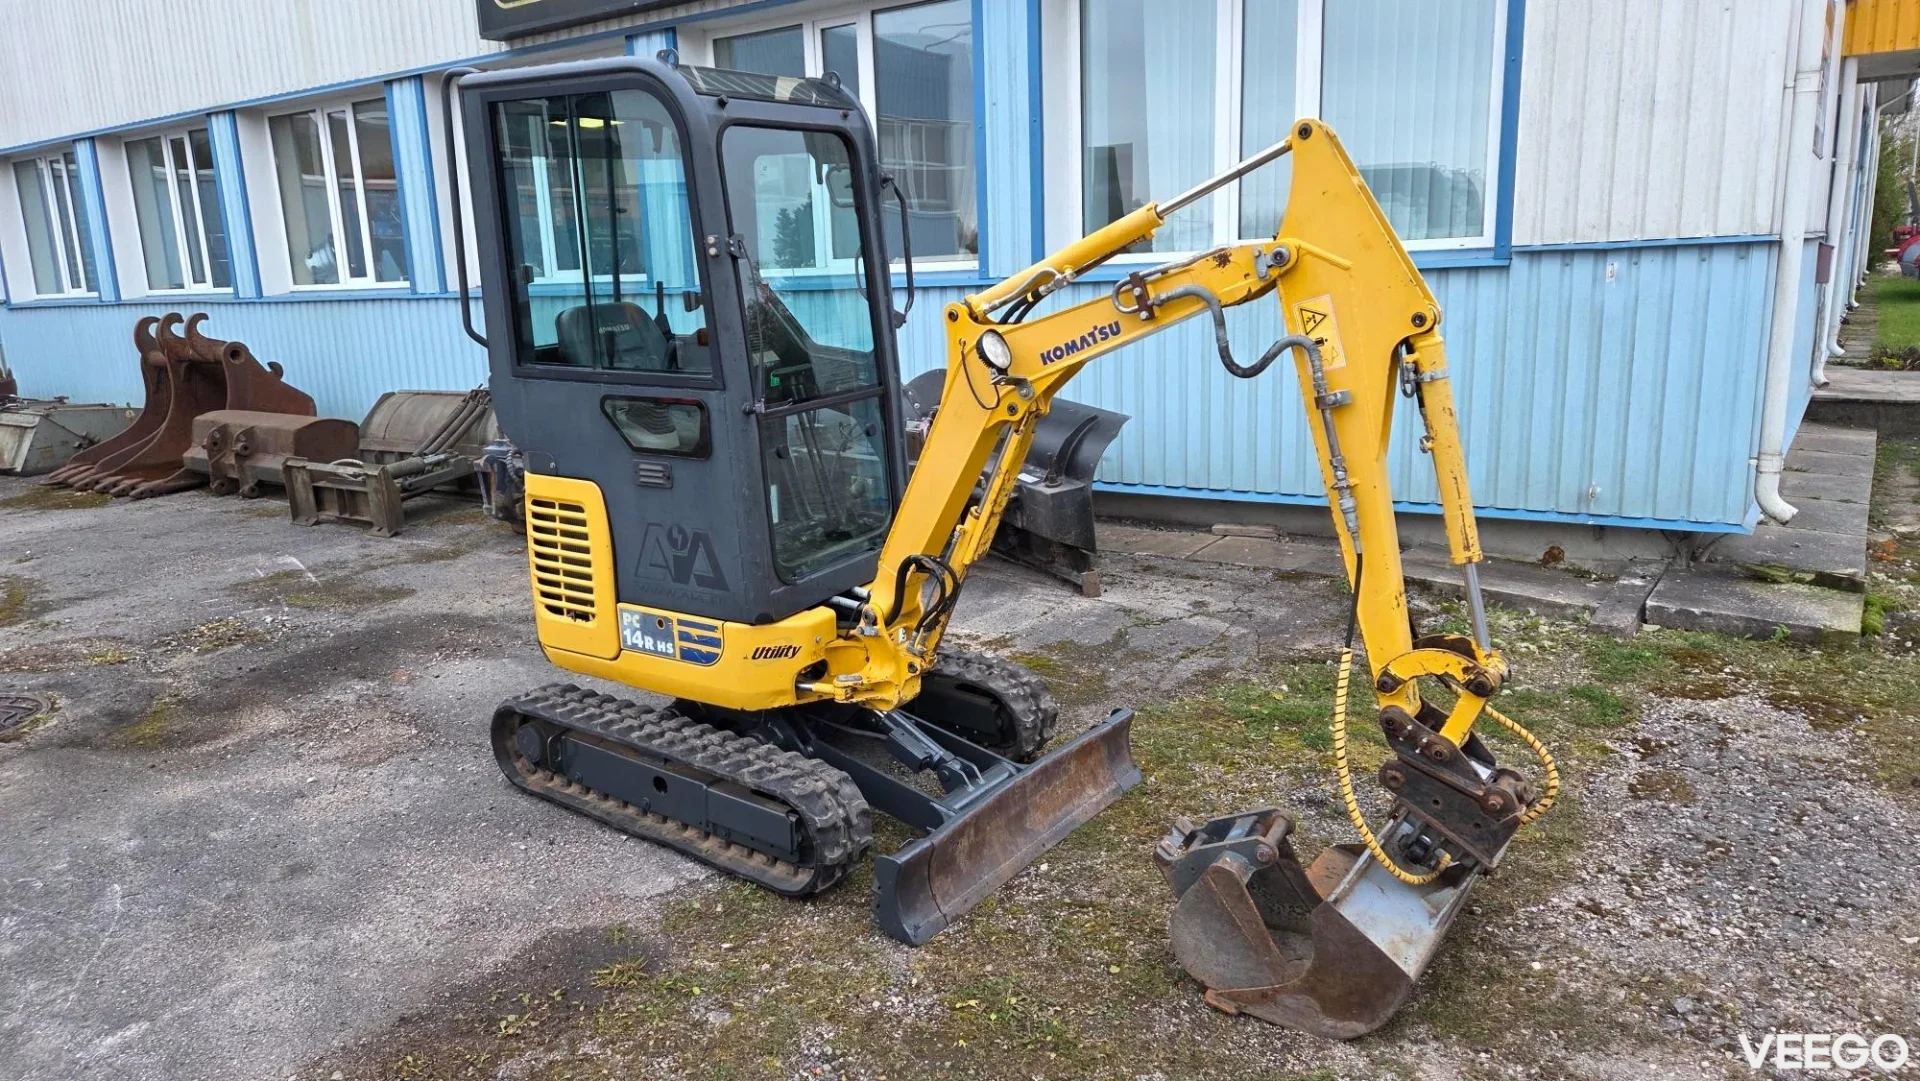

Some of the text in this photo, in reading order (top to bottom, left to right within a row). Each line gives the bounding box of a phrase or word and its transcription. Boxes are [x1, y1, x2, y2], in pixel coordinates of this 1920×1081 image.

[1040, 321, 1121, 365] KOMATSU
[622, 612, 640, 629] PC
[656, 640, 674, 654] HS
[751, 644, 803, 660] Utility
